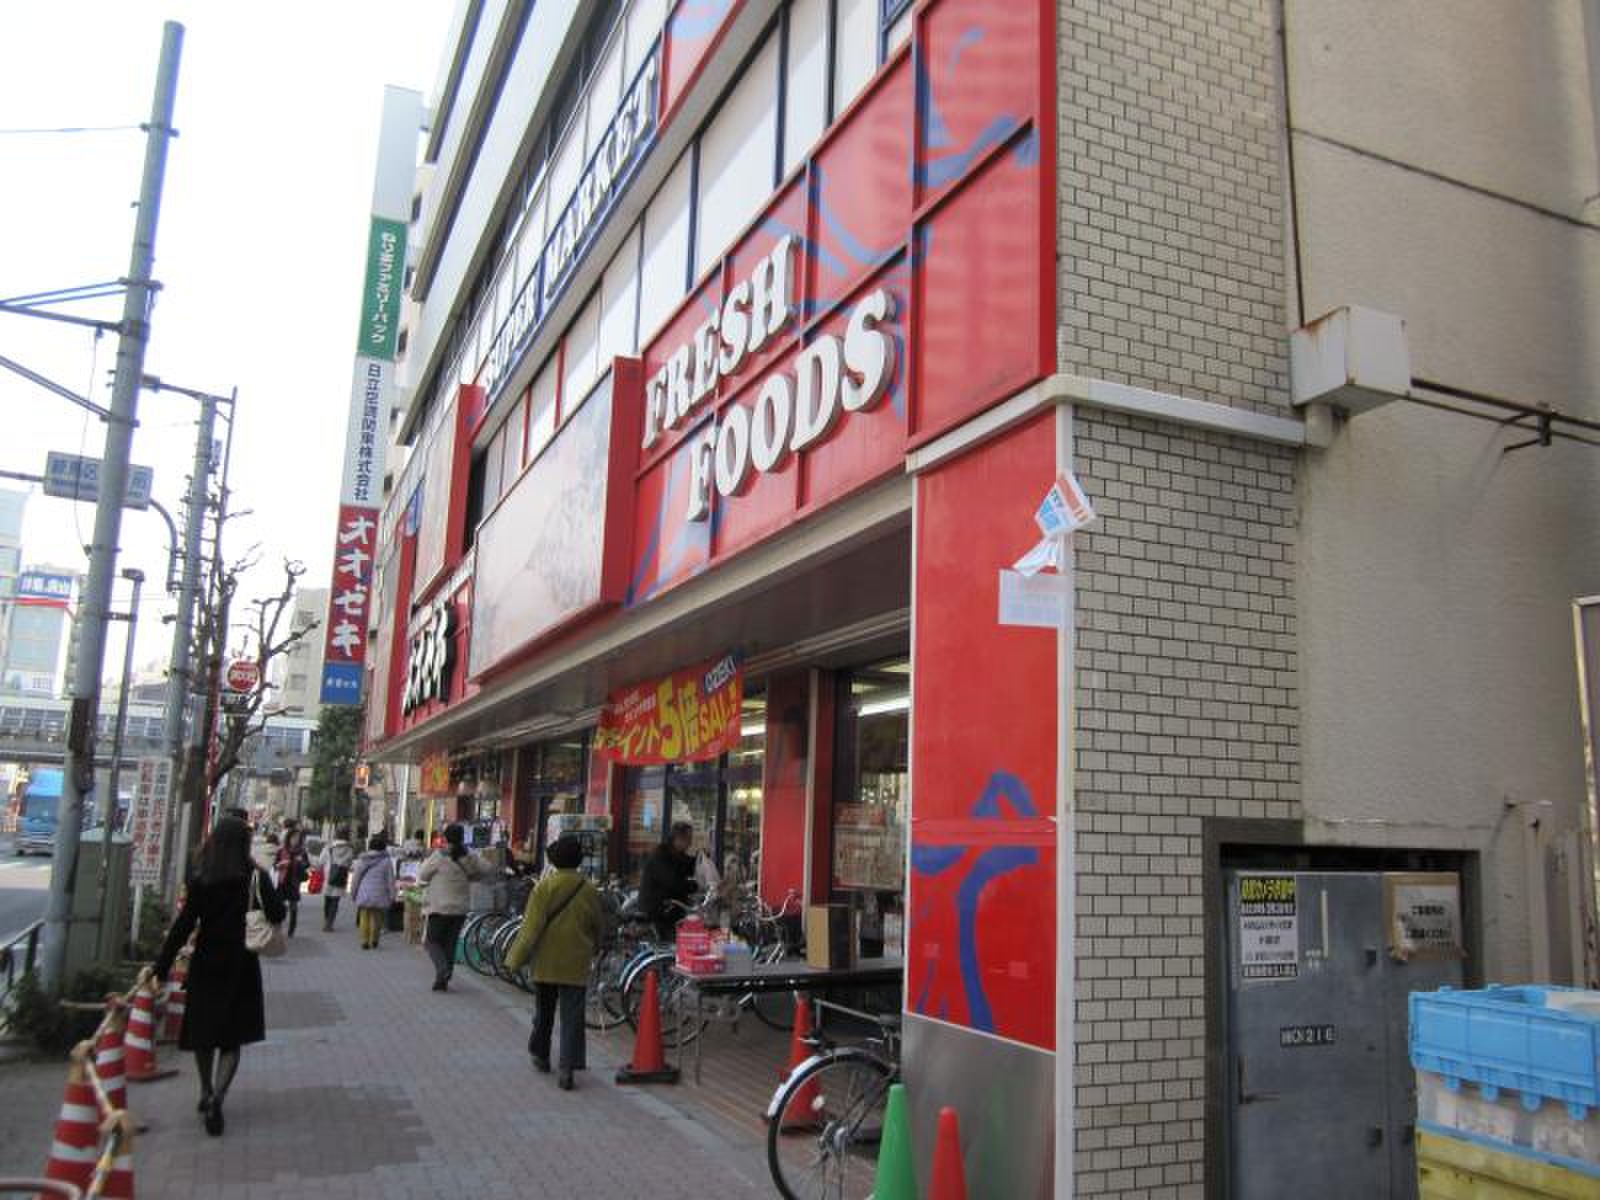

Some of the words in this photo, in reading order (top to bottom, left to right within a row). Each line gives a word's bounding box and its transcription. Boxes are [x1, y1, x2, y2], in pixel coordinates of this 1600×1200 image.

[641, 234, 797, 449] FRESH
[687, 288, 896, 522] FOODS
[331, 515, 376, 657] オオゼキ
